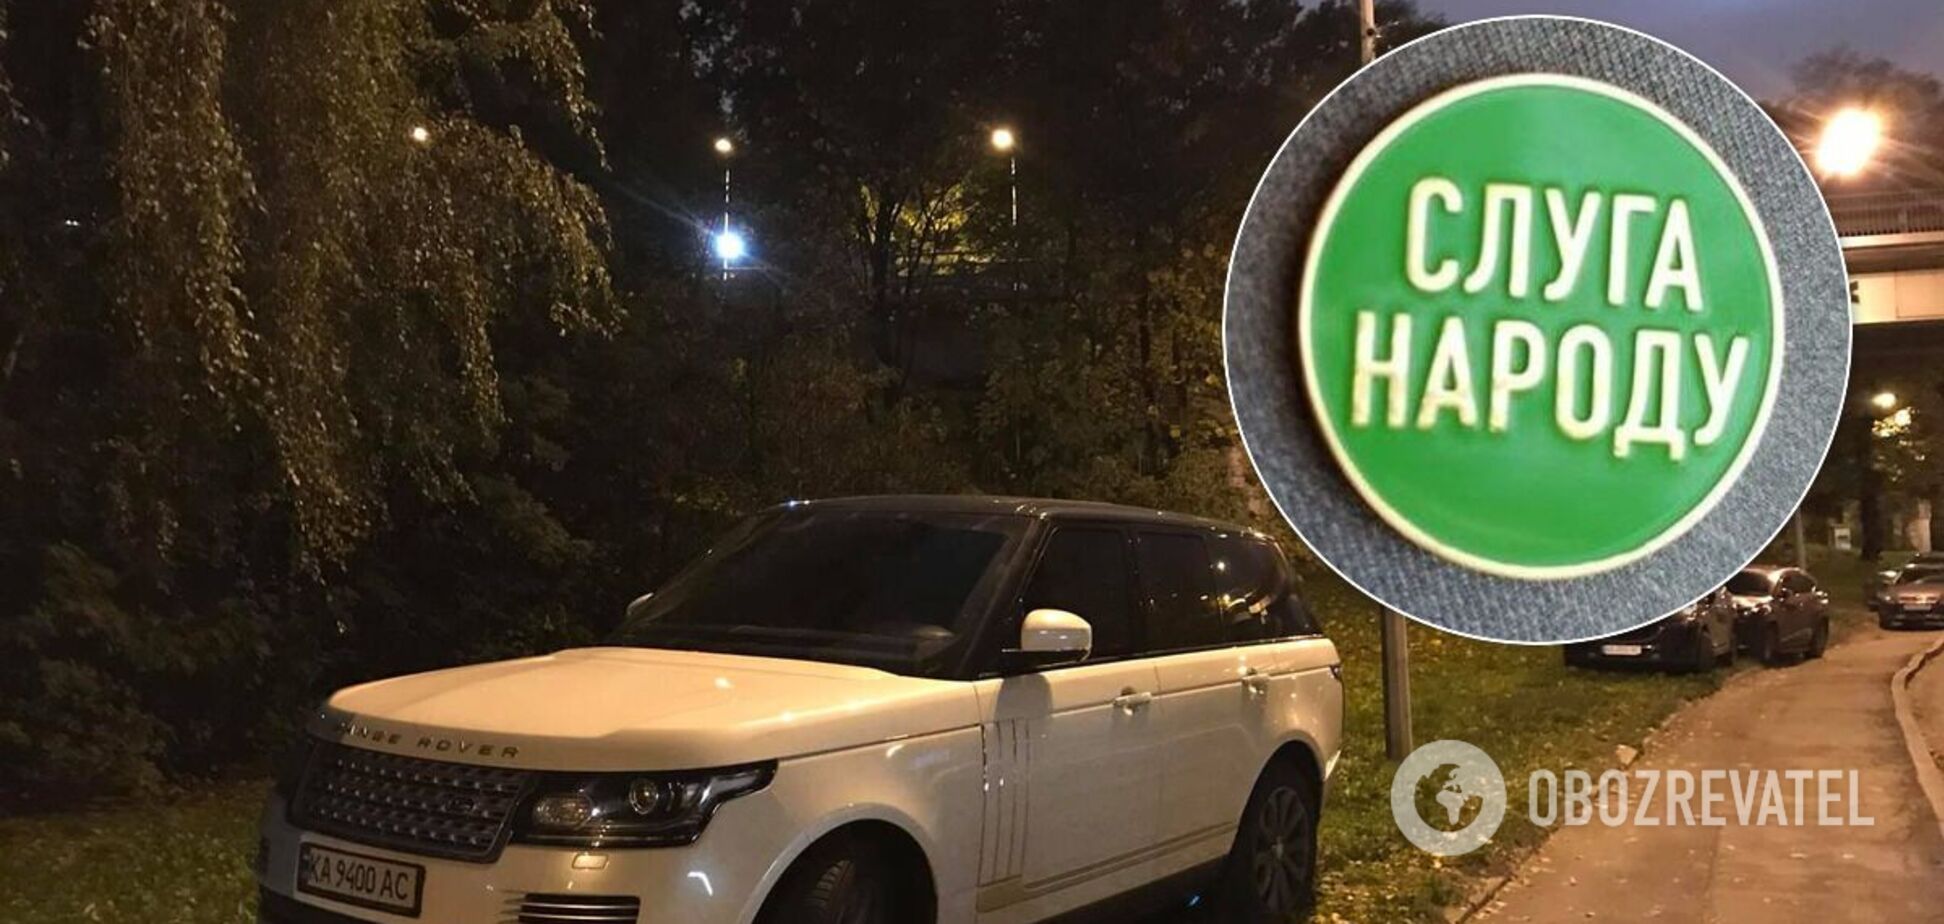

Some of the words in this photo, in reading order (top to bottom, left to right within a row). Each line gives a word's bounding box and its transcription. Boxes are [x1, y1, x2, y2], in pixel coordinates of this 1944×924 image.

[1405, 177, 1704, 312] СЛУГА
[1351, 310, 1750, 461] НАРОДУ
[416, 736, 519, 759] ROVER
[336, 859, 377, 894] 9400
[380, 868, 409, 900] AC
